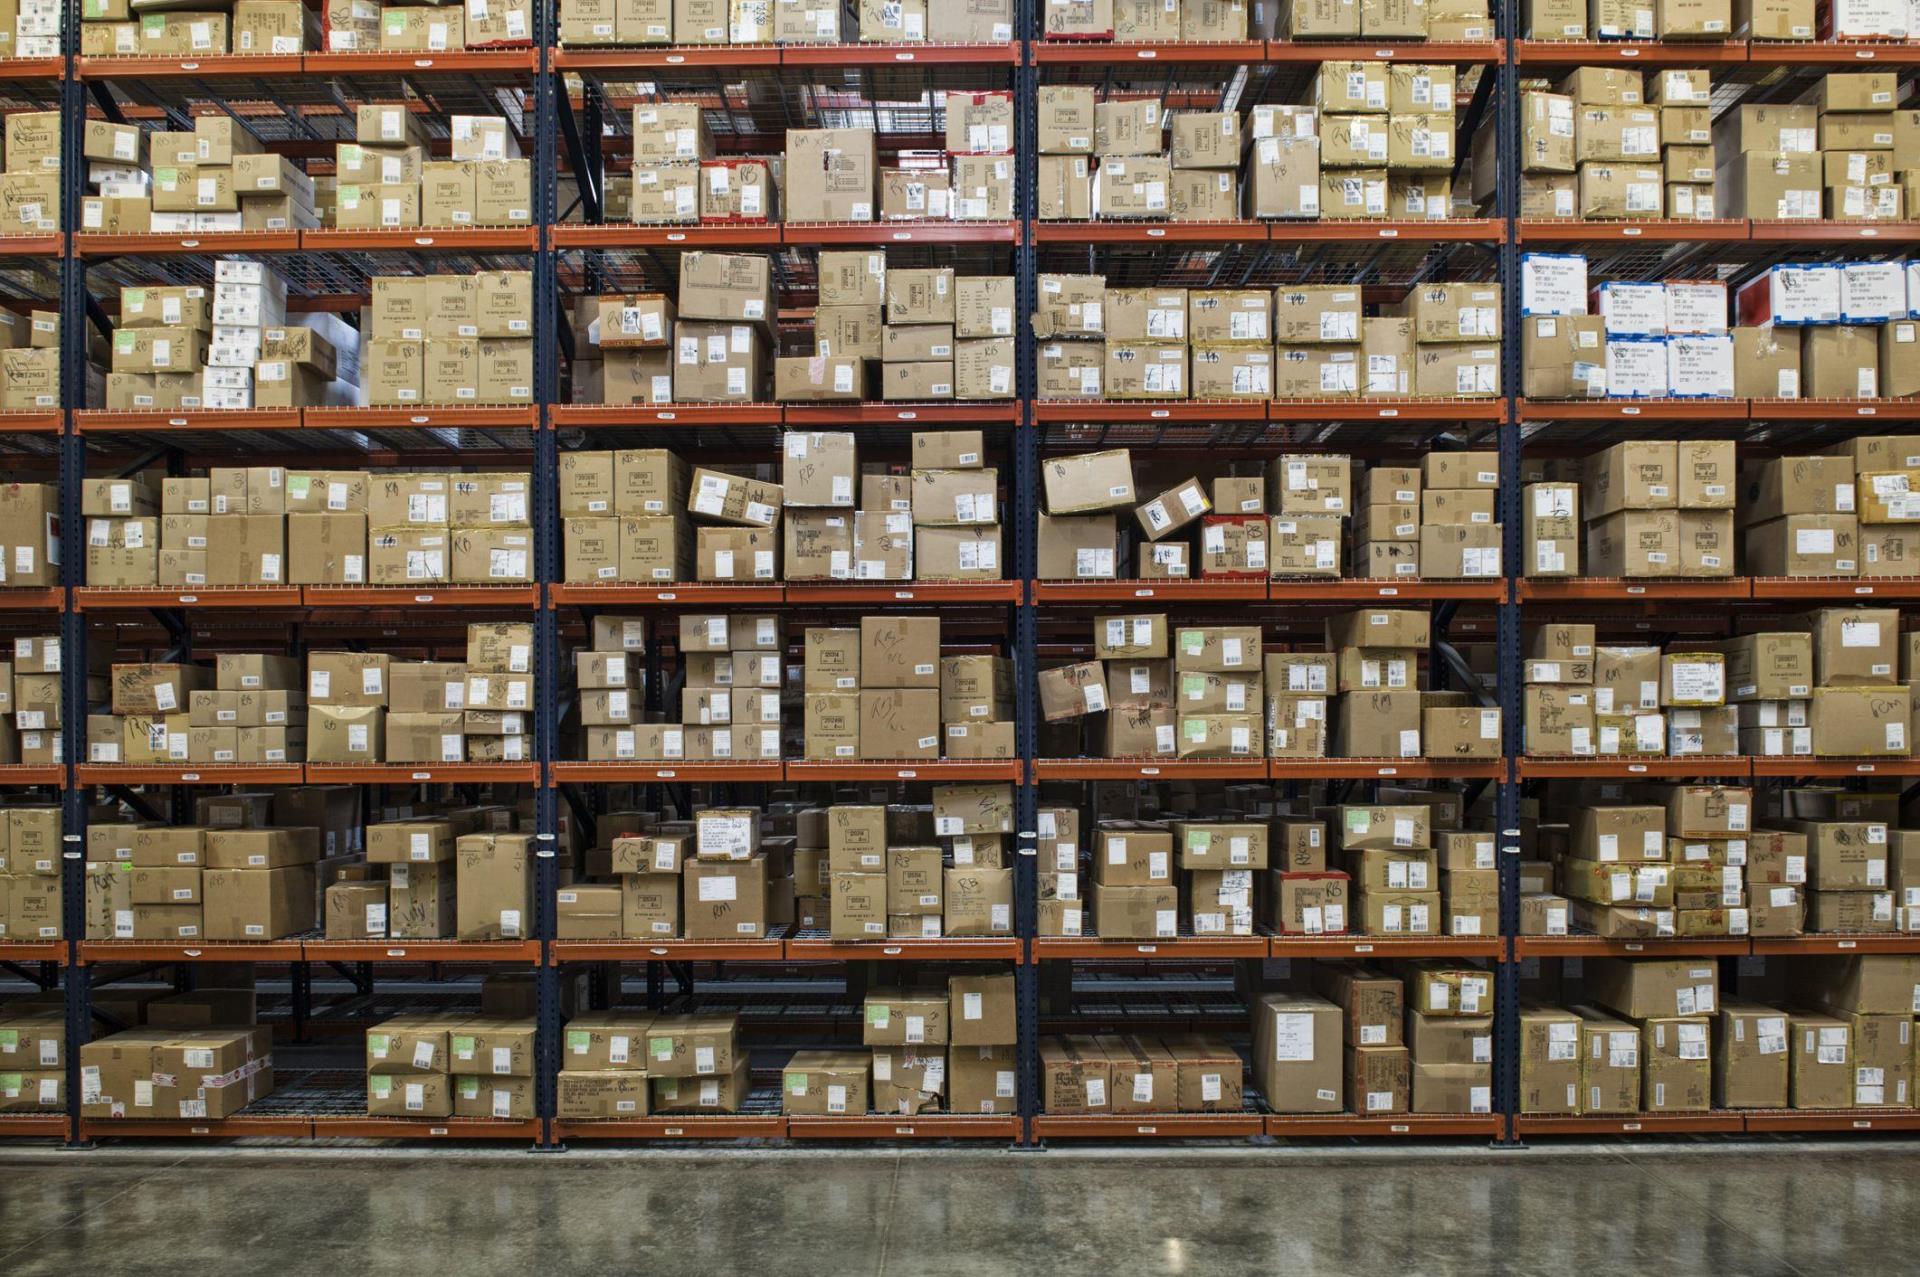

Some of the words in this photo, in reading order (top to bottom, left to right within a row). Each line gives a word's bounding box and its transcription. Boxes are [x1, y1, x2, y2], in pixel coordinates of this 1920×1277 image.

[799, 464, 814, 486] RB
[958, 878, 978, 892] RB
[712, 902, 731, 919] RM
